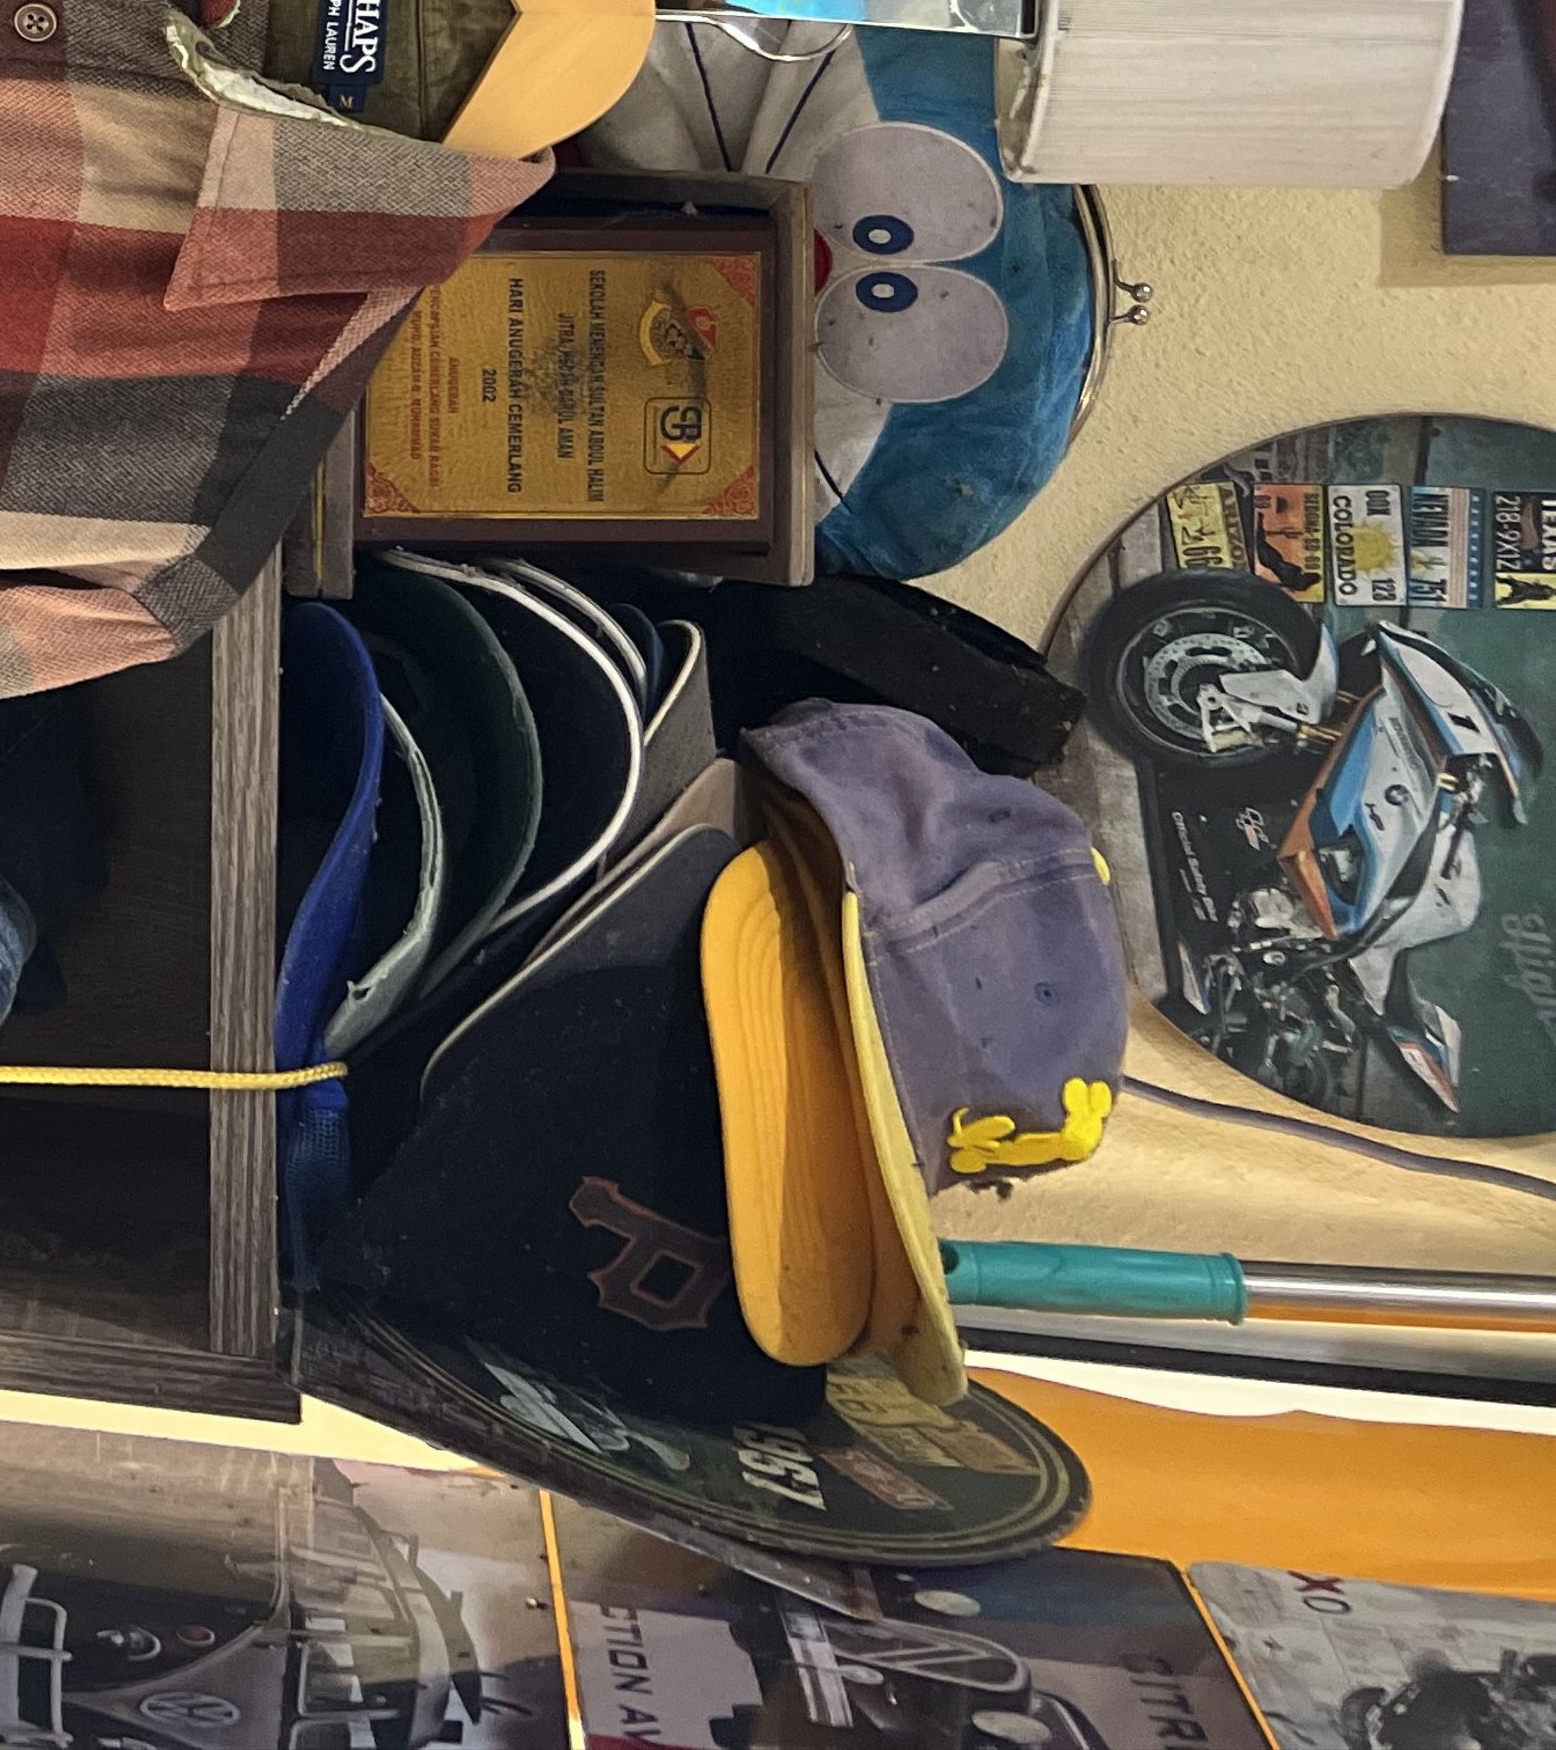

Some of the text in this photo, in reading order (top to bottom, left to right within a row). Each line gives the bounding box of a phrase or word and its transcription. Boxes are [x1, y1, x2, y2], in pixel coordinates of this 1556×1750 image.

[323, 21, 339, 70] LAUREN
[588, 270, 606, 319] SEKOLAH
[482, 369, 496, 402] 2002
[507, 278, 523, 493] HARI ANUGERAH CEMERLANG
[588, 387, 606, 426] SULTAN
[557, 428, 573, 458] AMAN
[587, 430, 606, 465] ABDUL
[587, 469, 605, 502] HALIM
[1411, 493, 1449, 547] NEVADA
[1332, 496, 1357, 595] COLORADO
[1371, 578, 1397, 600] 123
[1121, 1653, 1208, 1750] CITR
